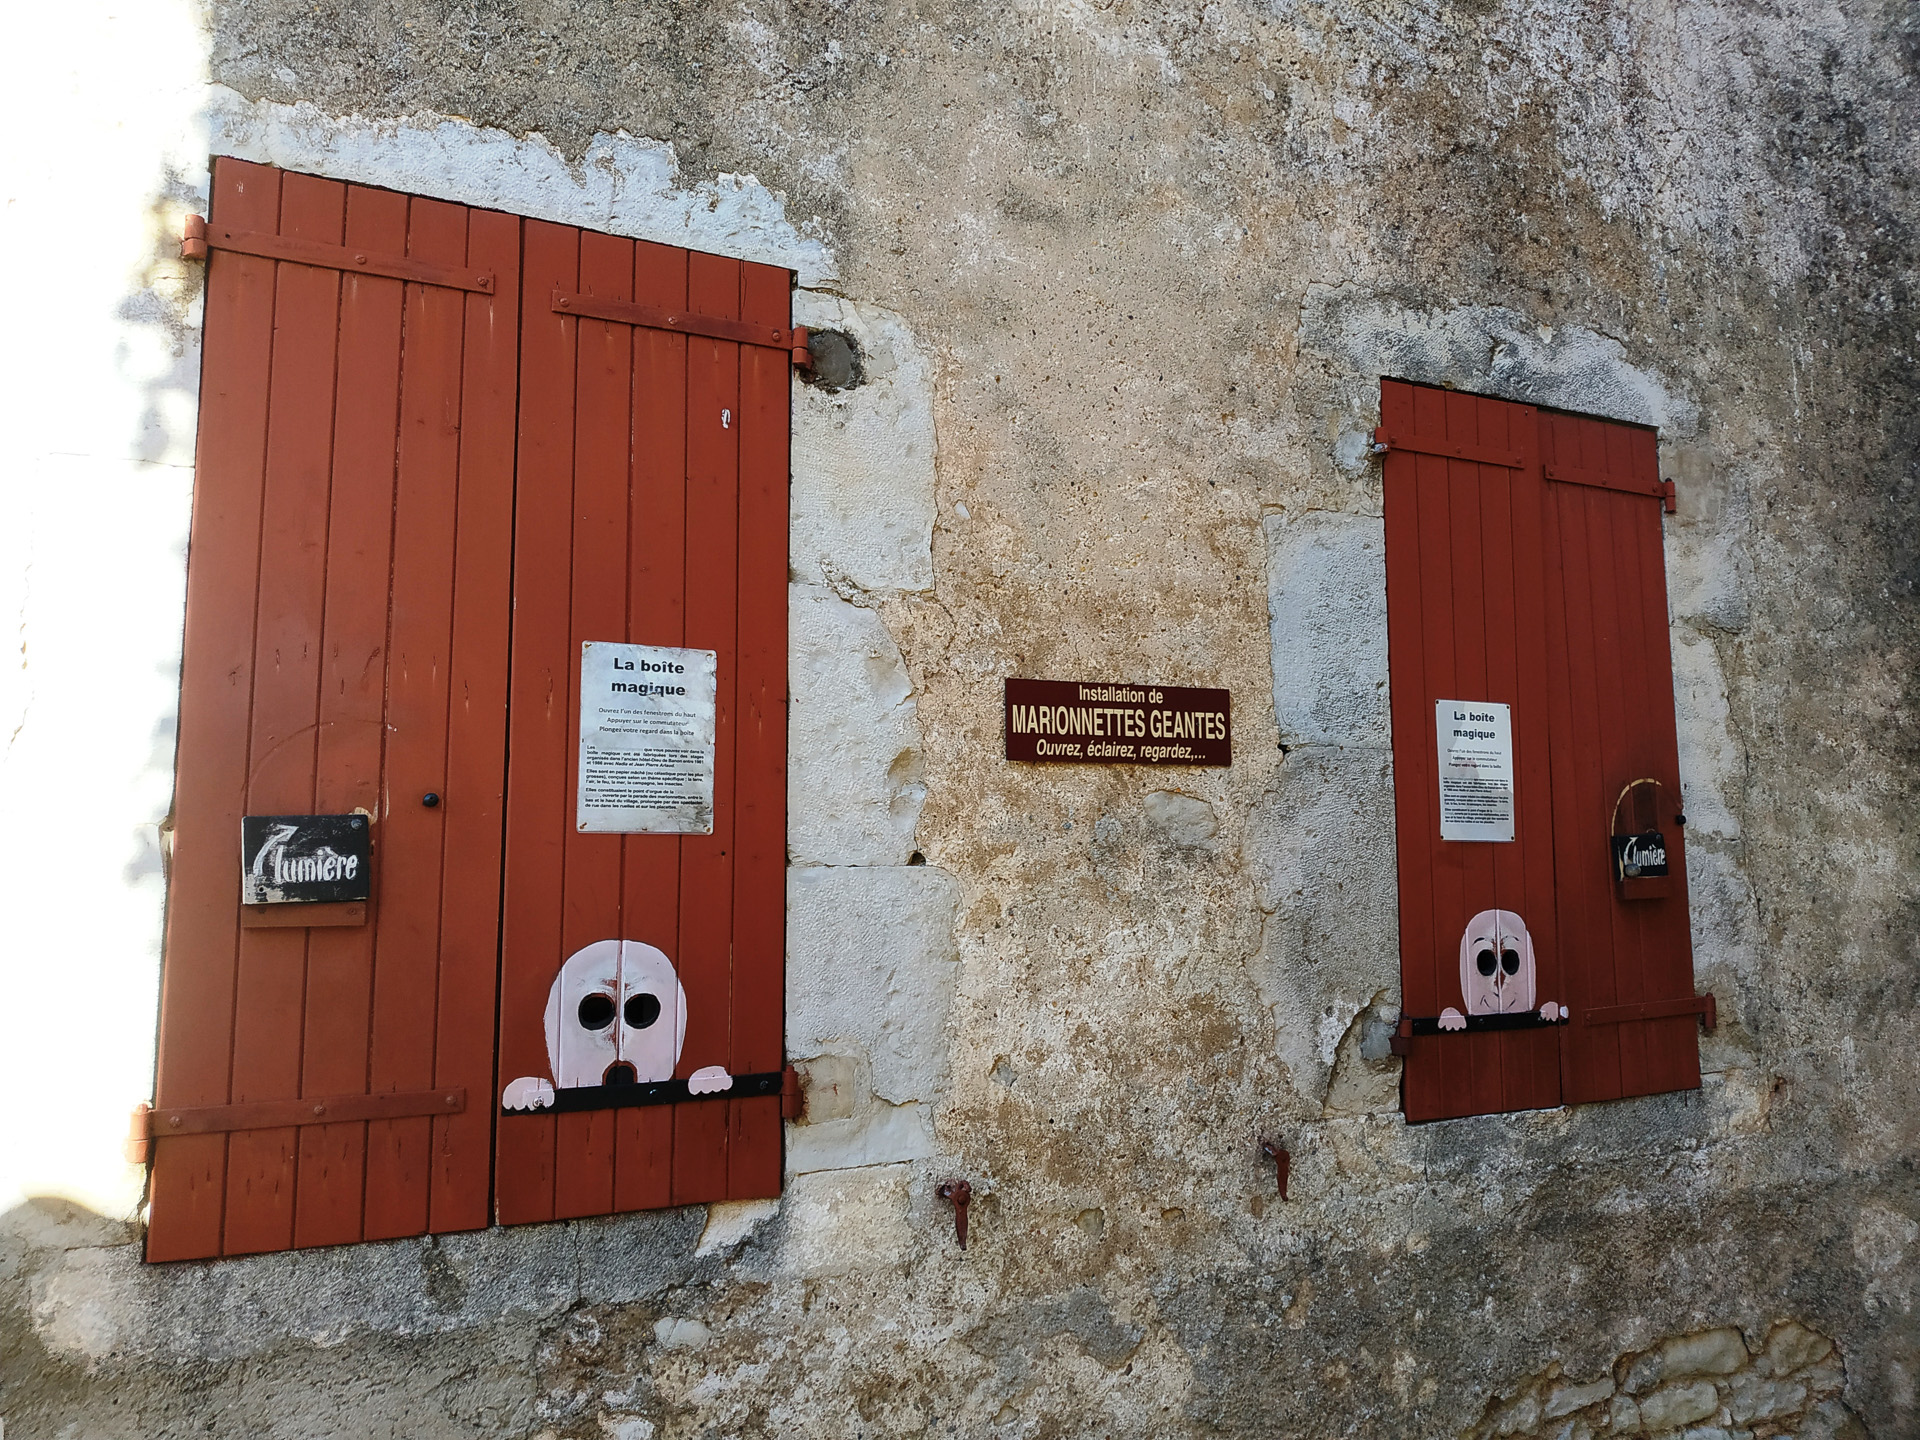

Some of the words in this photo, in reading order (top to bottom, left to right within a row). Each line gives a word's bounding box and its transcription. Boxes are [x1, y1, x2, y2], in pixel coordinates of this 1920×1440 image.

[613, 657, 634, 671] La
[640, 659, 685, 674] boîte
[611, 682, 686, 697] magique
[1079, 684, 1145, 703] Installation
[1148, 688, 1164, 704] de
[606, 717, 632, 725] Appuyer
[1012, 704, 1146, 738] MARIONNETTES
[1150, 709, 1226, 740] GEANTES
[1453, 710, 1466, 721] La
[599, 726, 622, 735] Plongez
[1453, 728, 1496, 740] magique
[1036, 738, 1083, 760] Ouvrez,
[1087, 740, 1137, 761] éclairez,
[275, 844, 358, 883] lumière
[1633, 843, 1666, 867] lumière
